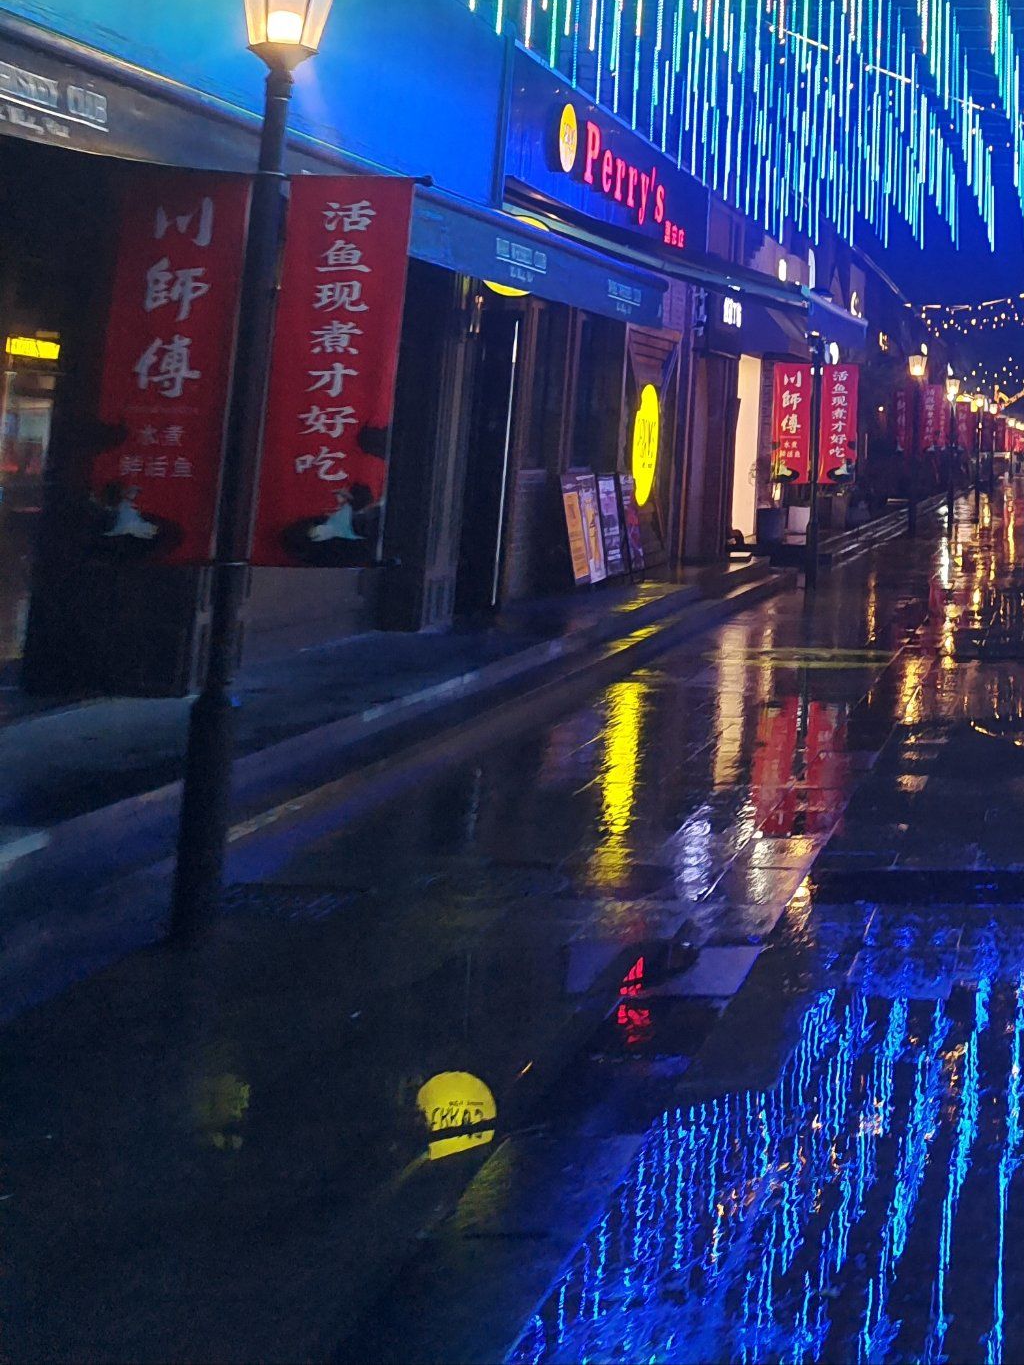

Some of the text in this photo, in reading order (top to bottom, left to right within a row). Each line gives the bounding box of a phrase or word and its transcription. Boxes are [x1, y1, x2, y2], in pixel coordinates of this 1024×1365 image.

[583, 121, 665, 226] Perry's
[134, 197, 214, 398] 川師傅
[295, 199, 377, 482] 活鱼现煮才好吃
[829, 370, 849, 458] 活鱼现煮才好吃
